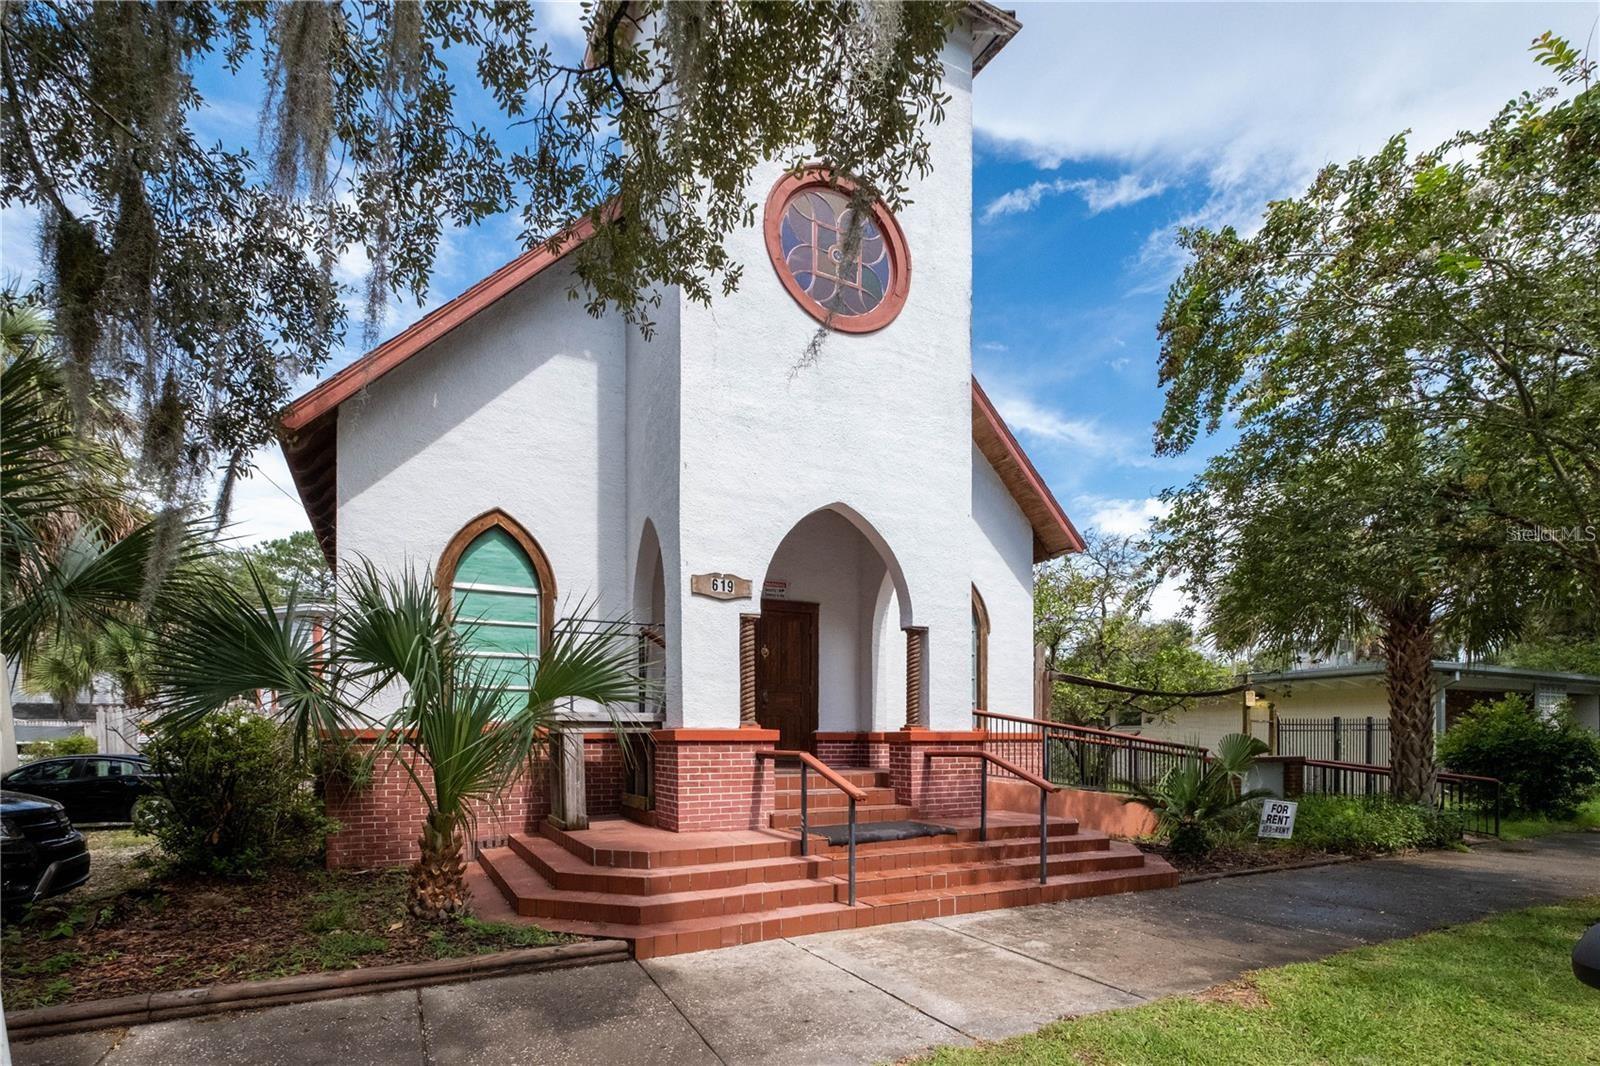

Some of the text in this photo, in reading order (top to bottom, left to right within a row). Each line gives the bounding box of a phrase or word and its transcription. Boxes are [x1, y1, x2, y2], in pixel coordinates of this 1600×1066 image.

[712, 578, 734, 593] 619
[1271, 803, 1289, 814] FOR
[1265, 814, 1290, 826] RENT
